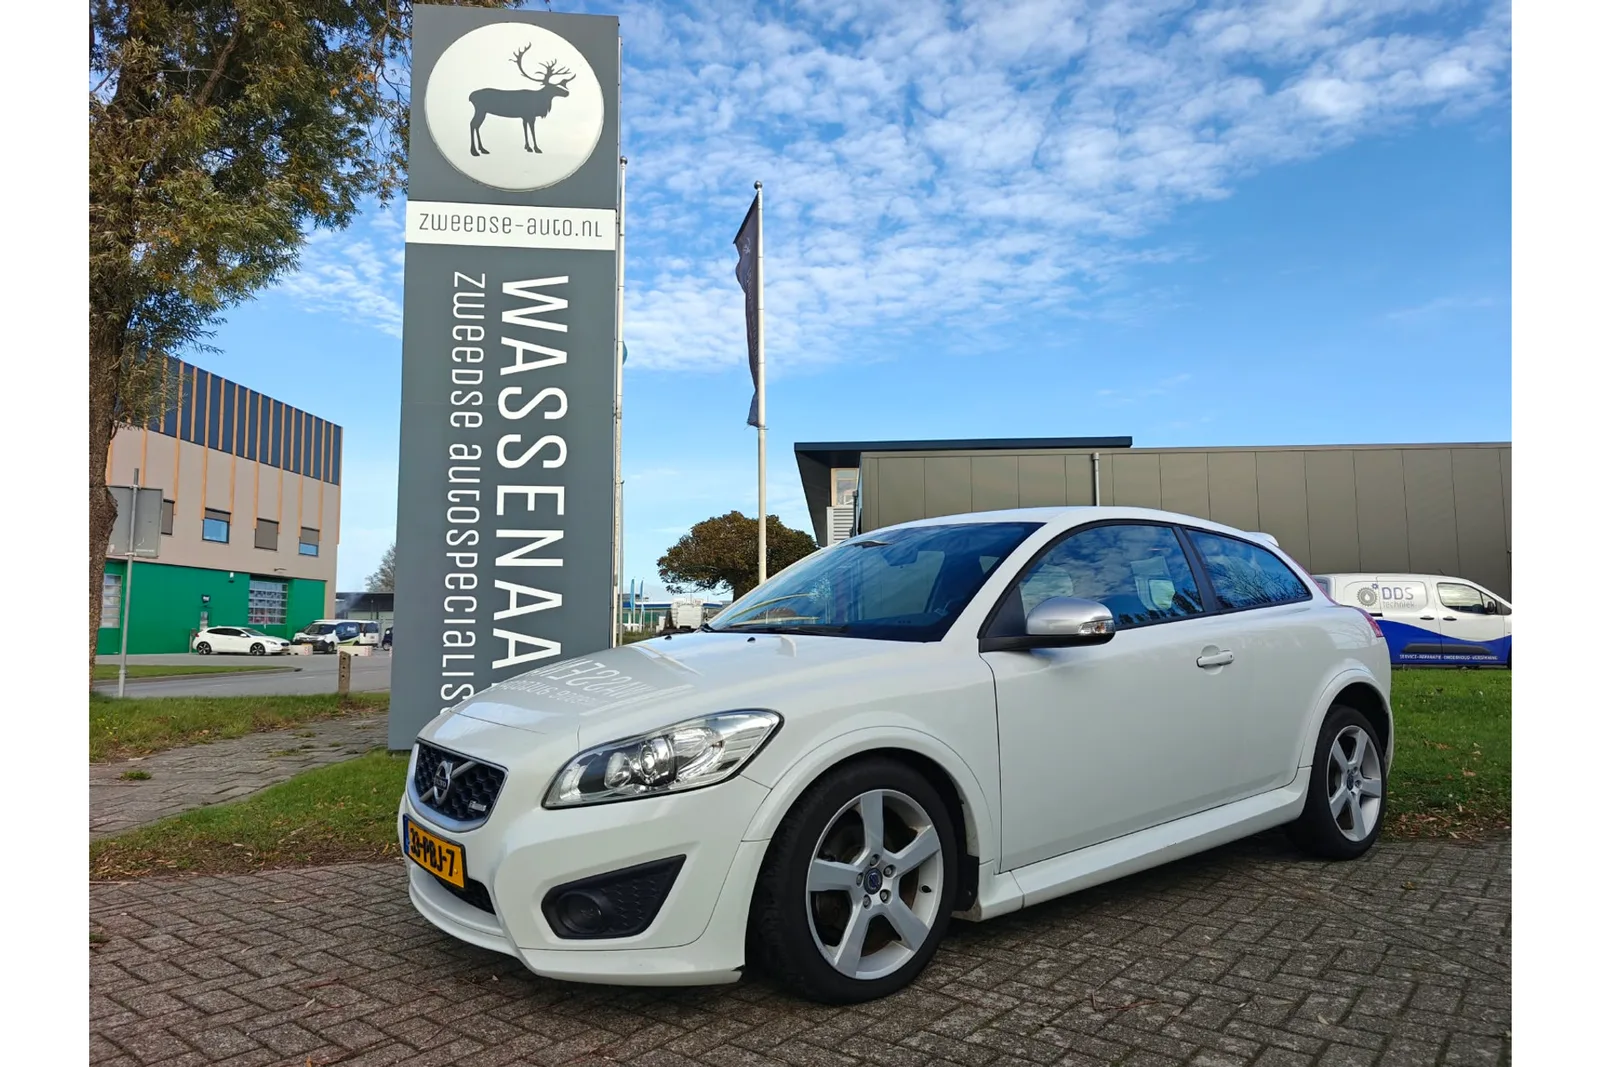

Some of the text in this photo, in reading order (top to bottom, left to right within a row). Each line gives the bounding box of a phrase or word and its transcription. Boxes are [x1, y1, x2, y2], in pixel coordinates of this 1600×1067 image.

[440, 443, 482, 714] autospecialis
[491, 275, 569, 687] WASSENAA
[1382, 586, 1414, 600] DDS
